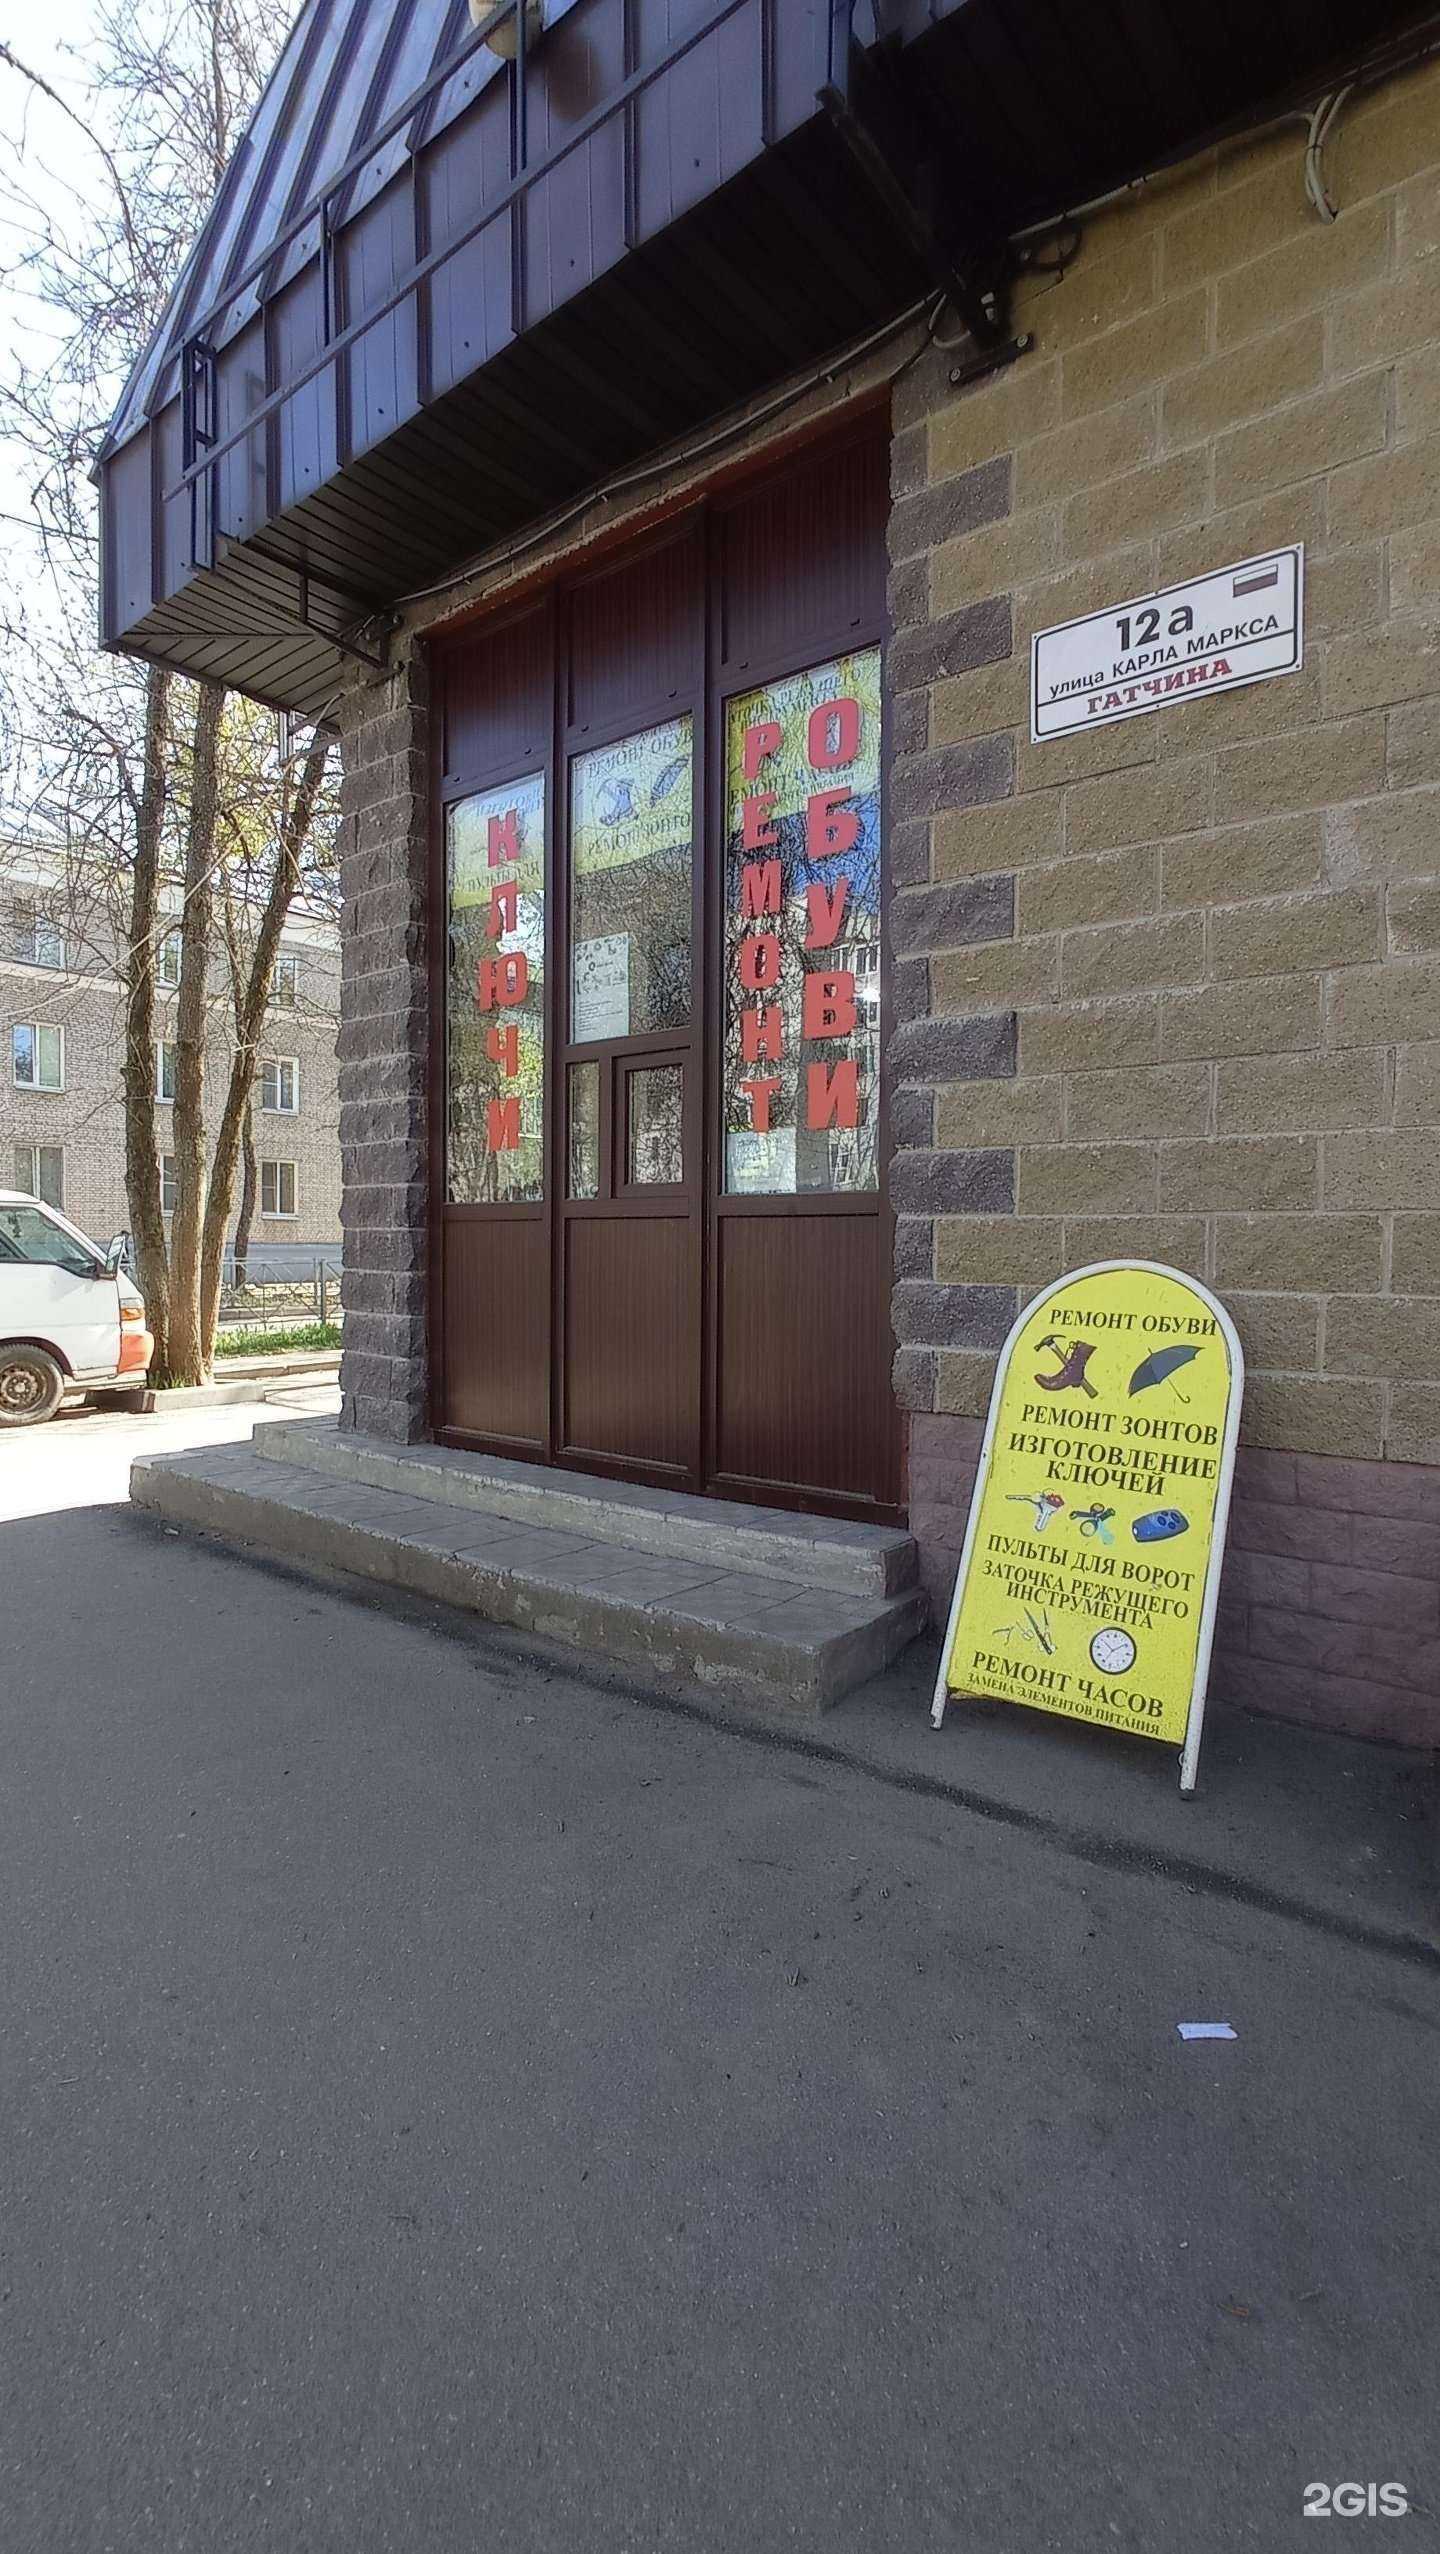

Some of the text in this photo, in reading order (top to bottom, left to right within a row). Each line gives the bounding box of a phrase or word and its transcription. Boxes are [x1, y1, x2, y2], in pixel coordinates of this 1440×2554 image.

[1050, 614, 1279, 698] улица КАРЛА МАРКСА
[1116, 604, 1194, 650] 12а
[1087, 658, 1232, 714] ГАТЧИНА
[742, 721, 784, 1132] РЕМОНТ
[805, 698, 860, 1131] ОБУВИ
[479, 808, 528, 1152] КЛЮЧИ
[1050, 1309, 1217, 1336] РЕМОНТ ОБУВИ
[1022, 1404, 1218, 1446] РЕМОНТ ЗОНТОВ
[1008, 1433, 1217, 1480] ИЗГОТОВЛЕНИЕ
[1047, 1460, 1166, 1496] КЛЮЧЕЙ
[982, 1559, 1189, 1619] ЗАТОЧКА РЕЖУЩЕГО
[988, 1534, 1195, 1593] ПУЛЬТЫ ДЛЯ ВОРОТ
[1007, 1582, 1153, 1629] ИНСТРУМЕНТА
[967, 1672, 1160, 1735] ЗАМЕНА ЭЛЕМЕНТОВ ПИТАНИЯ
[971, 1651, 1164, 1718] РЕМОНТ ЧАСОВ
